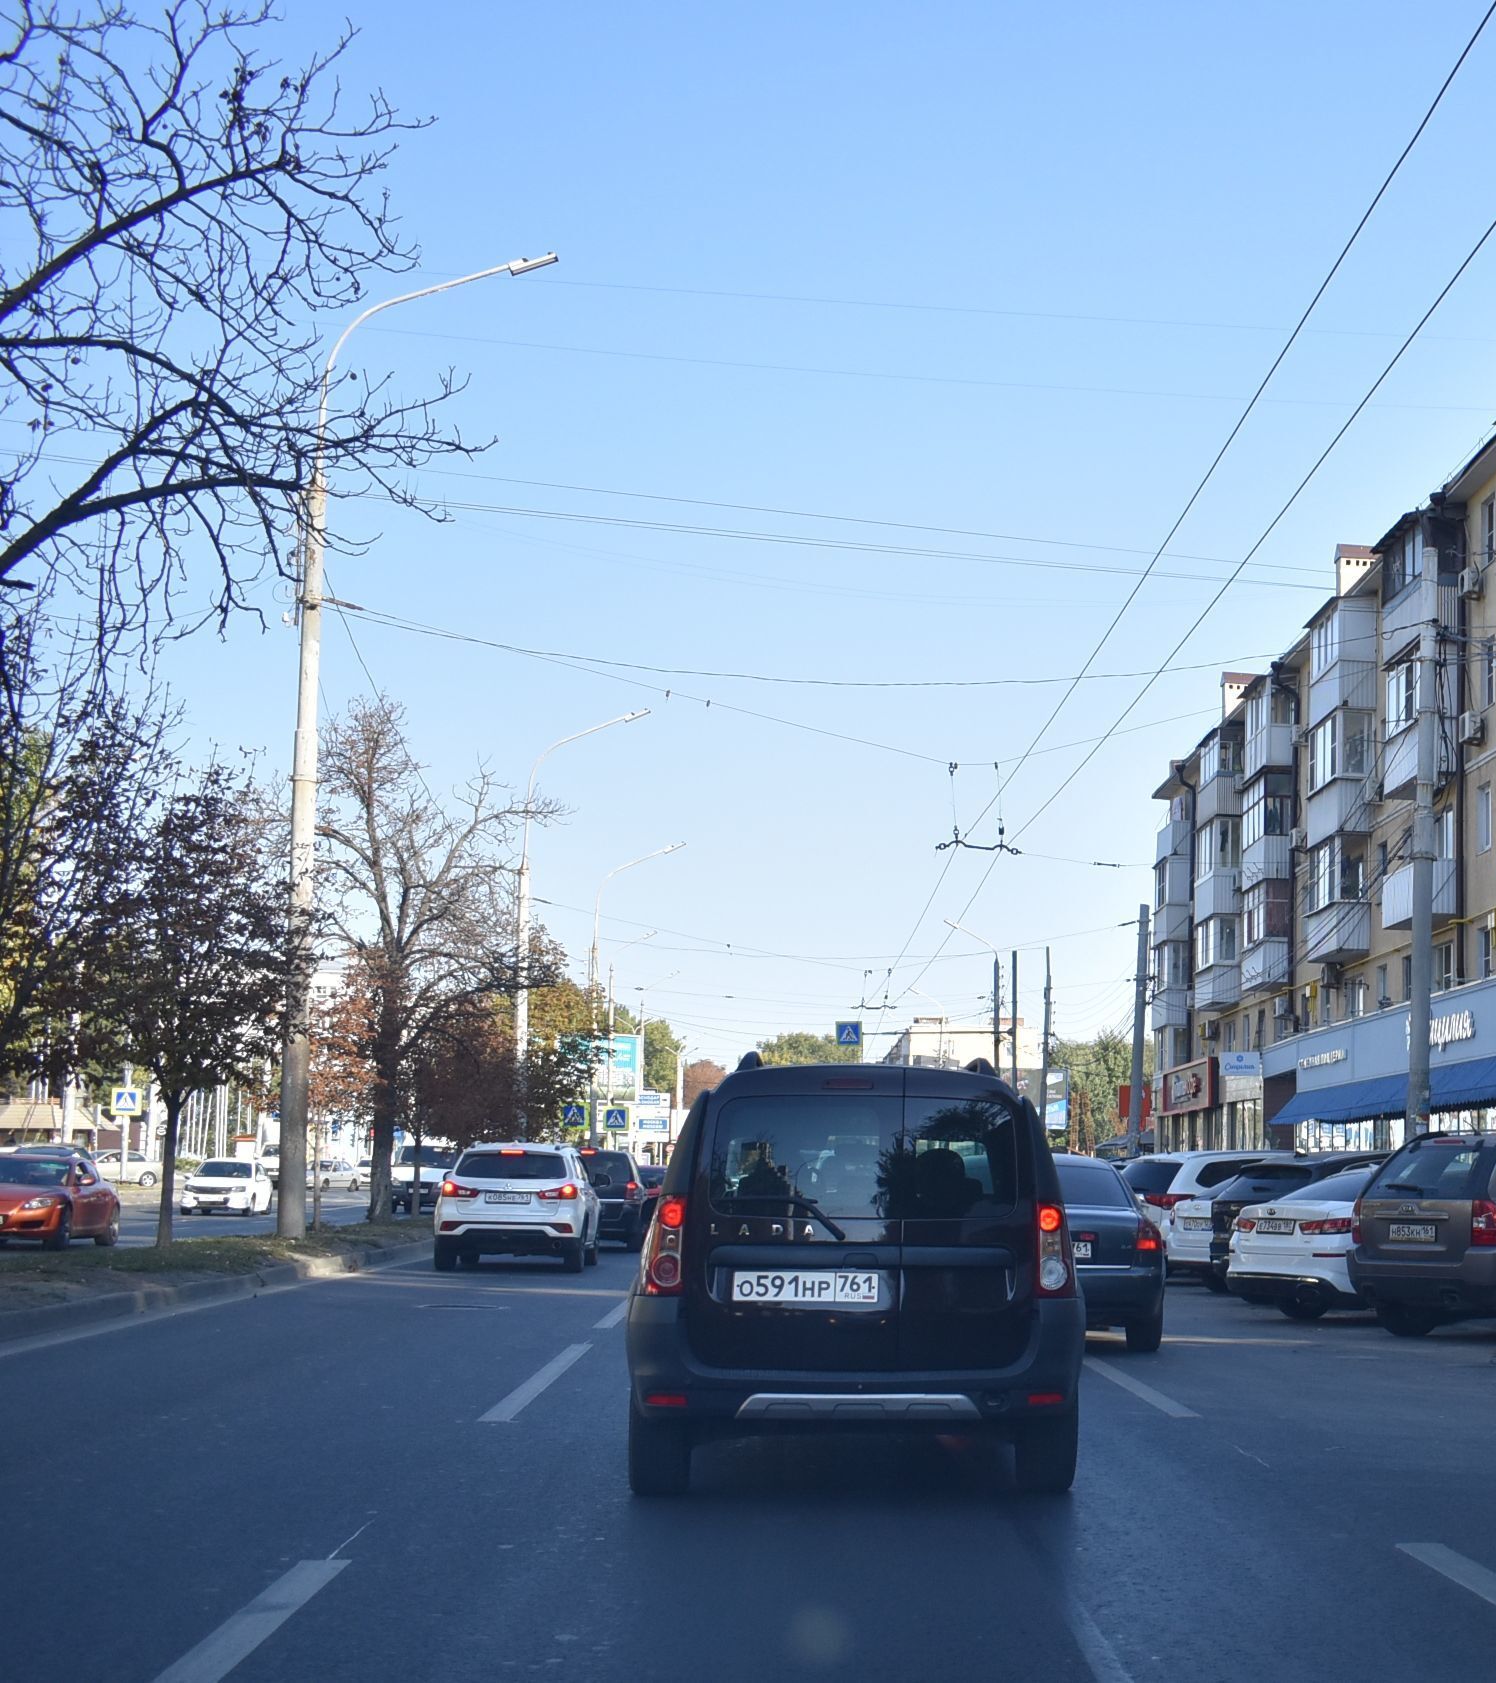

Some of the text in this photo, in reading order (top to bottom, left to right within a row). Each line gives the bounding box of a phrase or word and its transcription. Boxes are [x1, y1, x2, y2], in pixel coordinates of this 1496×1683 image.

[710, 1223, 814, 1237] LADA
[738, 1274, 873, 1299] О591НР 761
[844, 1292, 862, 1300] RUS
